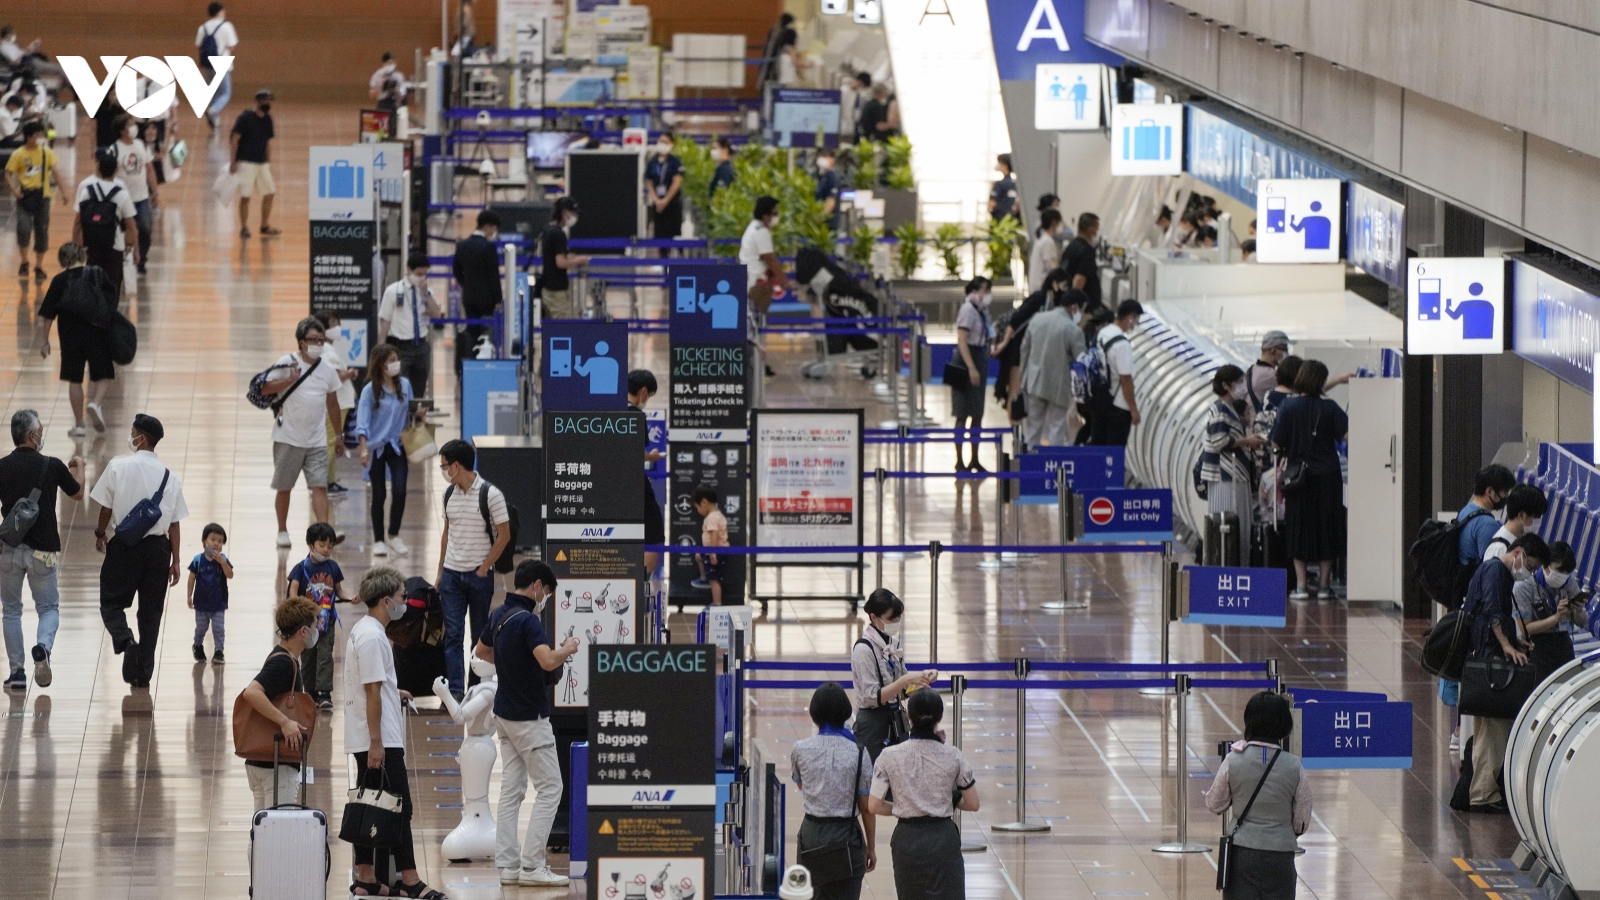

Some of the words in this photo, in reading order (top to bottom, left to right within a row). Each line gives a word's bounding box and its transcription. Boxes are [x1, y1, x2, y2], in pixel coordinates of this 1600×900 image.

[919, 0, 955, 25] A
[1016, 0, 1070, 51] A
[373, 151, 387, 171] 4
[1266, 182, 1273, 194] 6
[313, 226, 370, 238] BAGGAGE
[1417, 262, 1426, 276] 6
[344, 277, 371, 286] Baggage
[674, 347, 743, 361] TICKETING
[730, 362, 743, 376] IN
[673, 397, 706, 407] Ticketing
[707, 397, 713, 405] &
[714, 397, 735, 405] Check
[554, 417, 638, 434] BAGGAGE
[554, 462, 591, 475] 手荷物
[1045, 460, 1074, 475] 出口
[554, 480, 592, 490] Baggage
[1045, 480, 1074, 490] EXT
[1123, 499, 1161, 510] 出口専用
[554, 507, 576, 516] 수화물
[580, 507, 595, 515] 수속
[1123, 513, 1139, 521] Exit
[1141, 512, 1160, 522] Only
[581, 528, 602, 536] ANA
[1218, 574, 1250, 591] 出口
[1218, 596, 1249, 607] EXIT
[597, 650, 706, 672] BAGGAGE
[598, 710, 646, 727] 手荷物
[1335, 710, 1371, 729] 出口
[597, 733, 648, 747] Baggage
[1335, 736, 1370, 748] EXIT
[598, 769, 626, 780] 수화물
[632, 769, 652, 780] 수속
[632, 791, 661, 801] ANA
